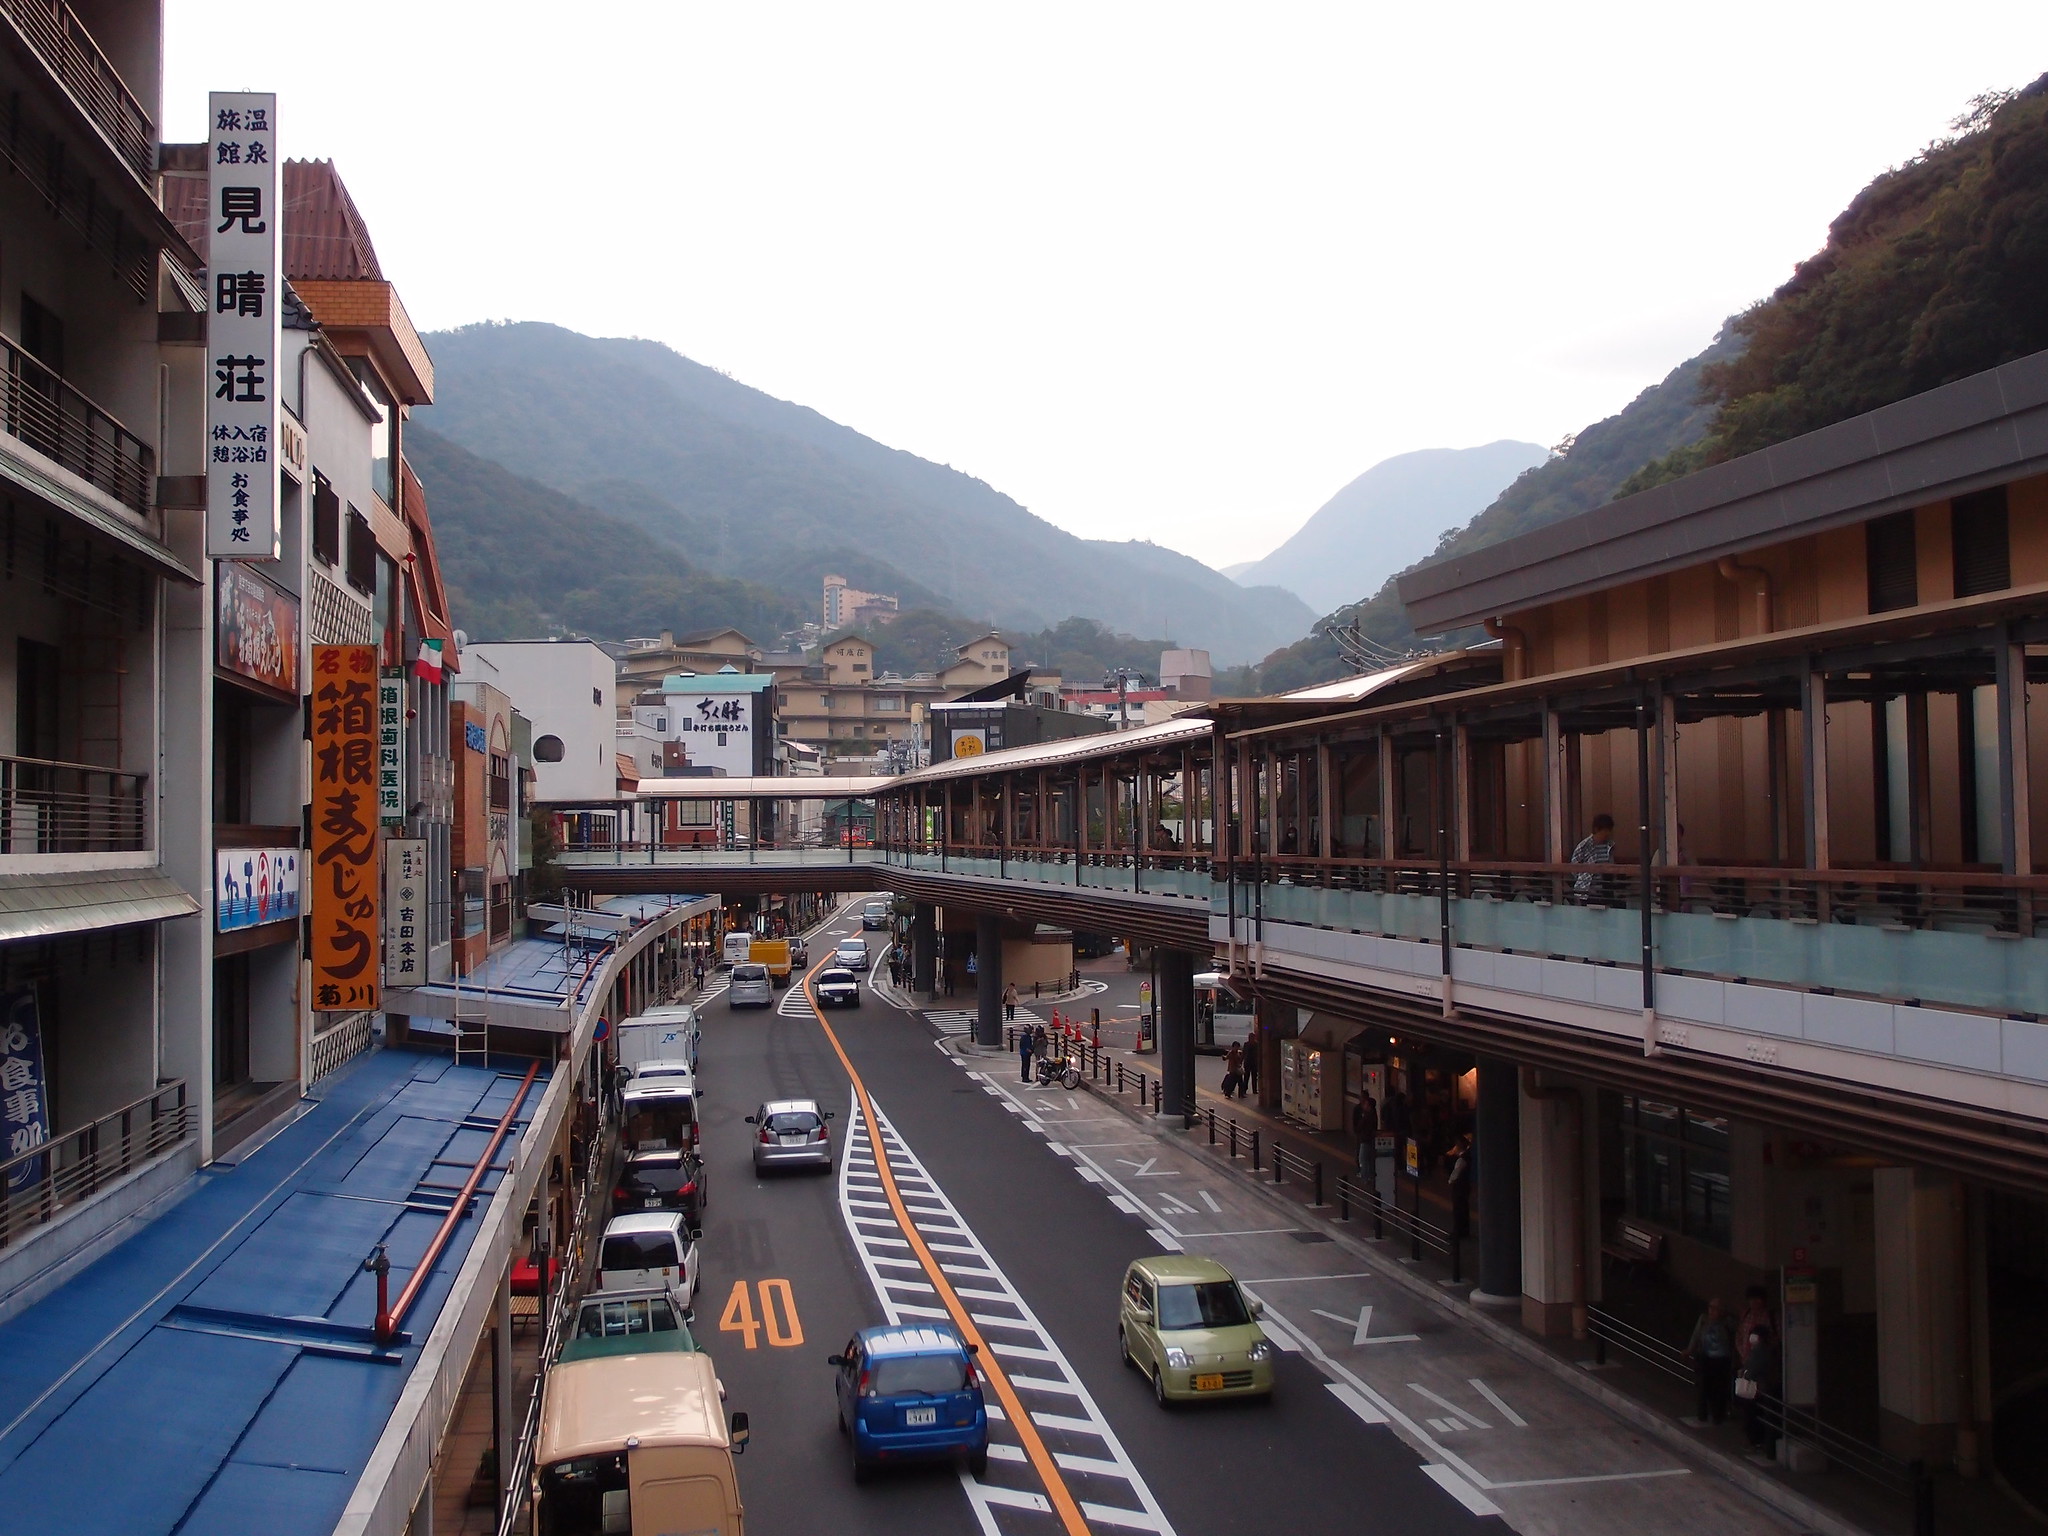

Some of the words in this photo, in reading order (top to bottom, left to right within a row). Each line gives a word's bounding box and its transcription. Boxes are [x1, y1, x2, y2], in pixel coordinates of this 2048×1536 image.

[216, 109, 241, 164] 旅館
[245, 109, 268, 164] 温泉
[216, 187, 266, 402] 見晴荘
[231, 425, 250, 463] 入浴
[249, 425, 267, 463] 宿泊
[231, 472, 250, 542] お食事処
[316, 648, 374, 675] 名物
[381, 686, 399, 809] 箱根歯科医院
[317, 679, 375, 980] 箱根まんじゅう
[400, 906, 416, 973] 吉田本店
[317, 983, 374, 1006] 菊川
[719, 1278, 805, 1349] 40
